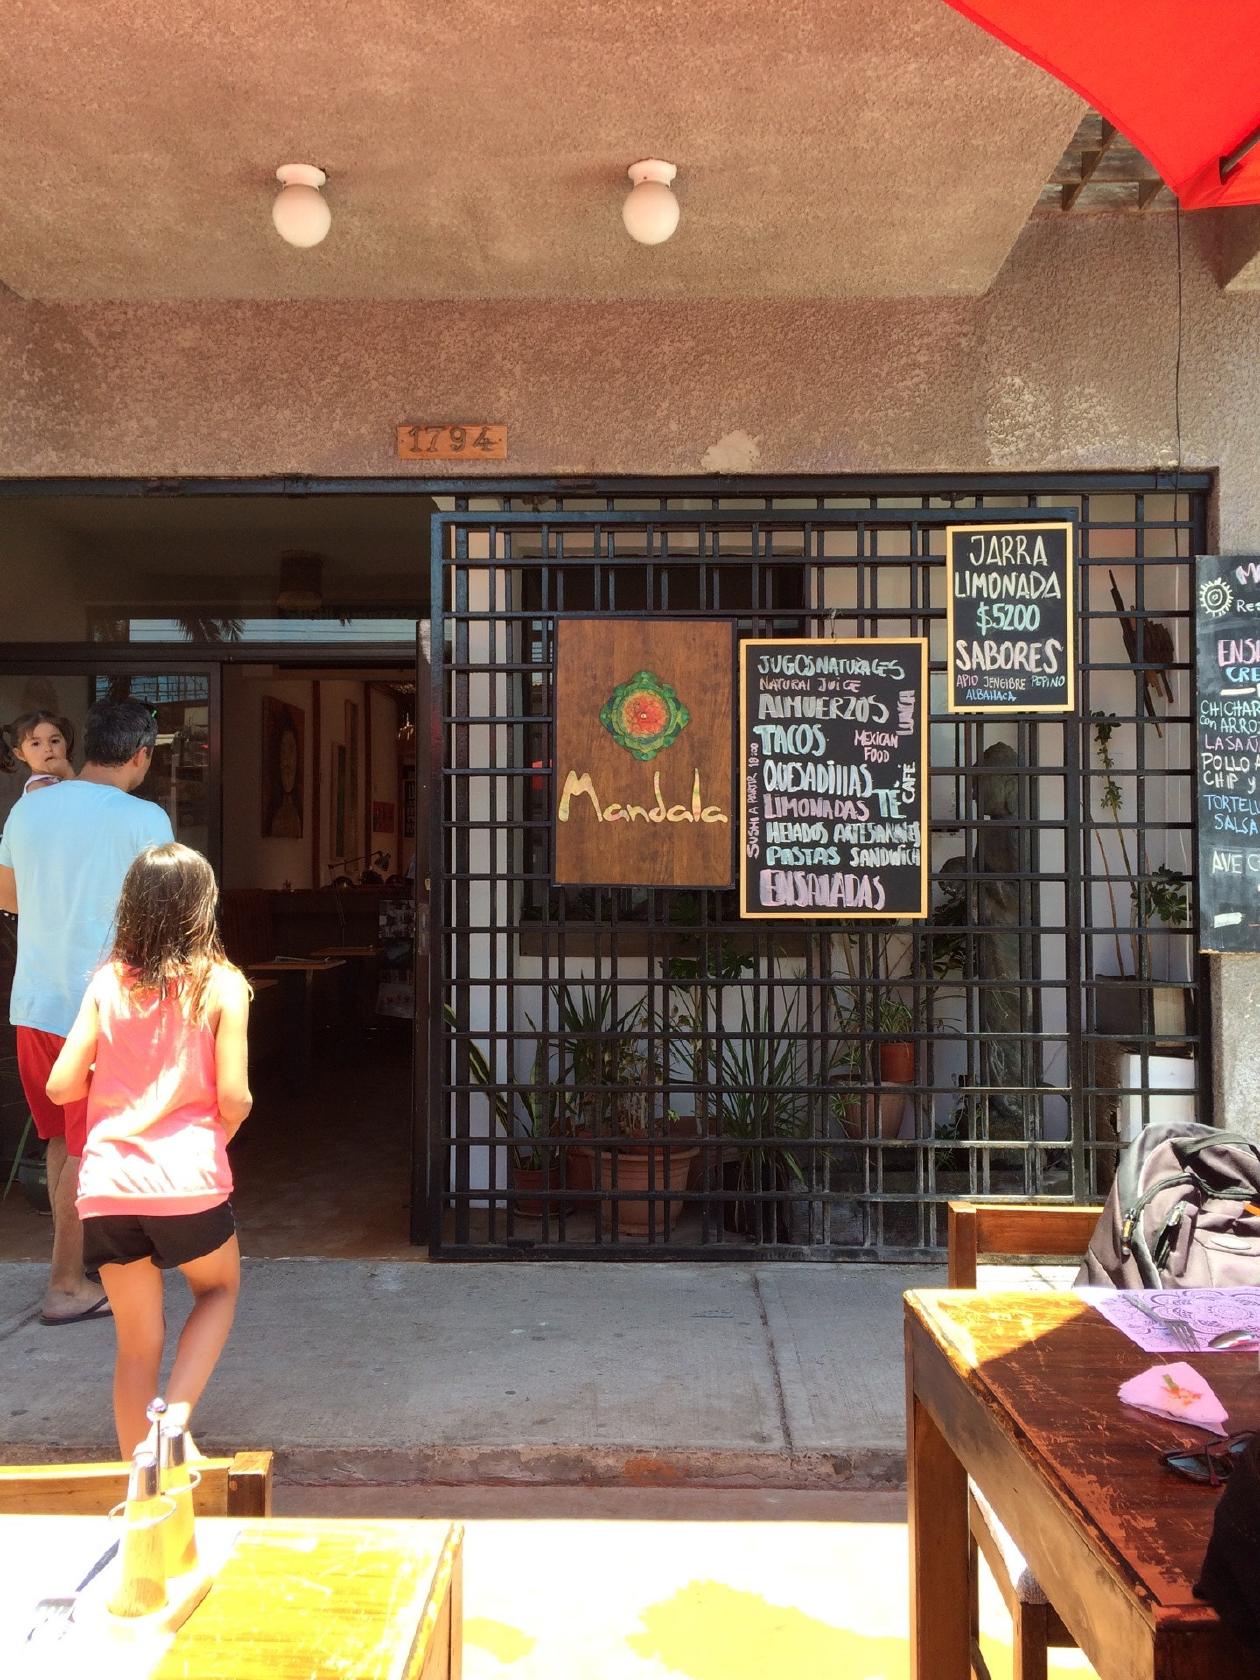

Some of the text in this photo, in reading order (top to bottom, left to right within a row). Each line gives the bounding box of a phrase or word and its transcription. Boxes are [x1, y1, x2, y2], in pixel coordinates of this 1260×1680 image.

[408, 426, 499, 453] 1794
[969, 535, 1048, 567] JARRA
[954, 571, 1062, 600] LIMONADA
[976, 601, 1041, 636] $5200
[757, 654, 815, 676] JUGOS
[956, 638, 1064, 674] SABORES
[759, 676, 811, 691] NATURAL
[956, 674, 1066, 690] APIO JENGIBRE PEPINO
[966, 688, 1017, 702] ALBAHACA
[758, 693, 890, 724] ALMUERZOS
[752, 724, 827, 757] TACOS
[853, 729, 899, 749] MEXICAN
[1205, 733, 1260, 752] LASAÑ
[864, 749, 890, 763] FOOD
[1201, 752, 1250, 772] POLLO
[763, 759, 873, 798] QUESADILLAS
[558, 768, 728, 823] Mandala
[763, 793, 870, 821] LIMONADAS
[748, 806, 759, 815] A
[766, 821, 829, 844] HELADOS
[1214, 813, 1258, 836] SALSA
[746, 816, 760, 860] SUSHI
[766, 846, 841, 866] PASTAS
[1212, 850, 1242, 874] AVE
[759, 869, 886, 910] ENSALADAS
